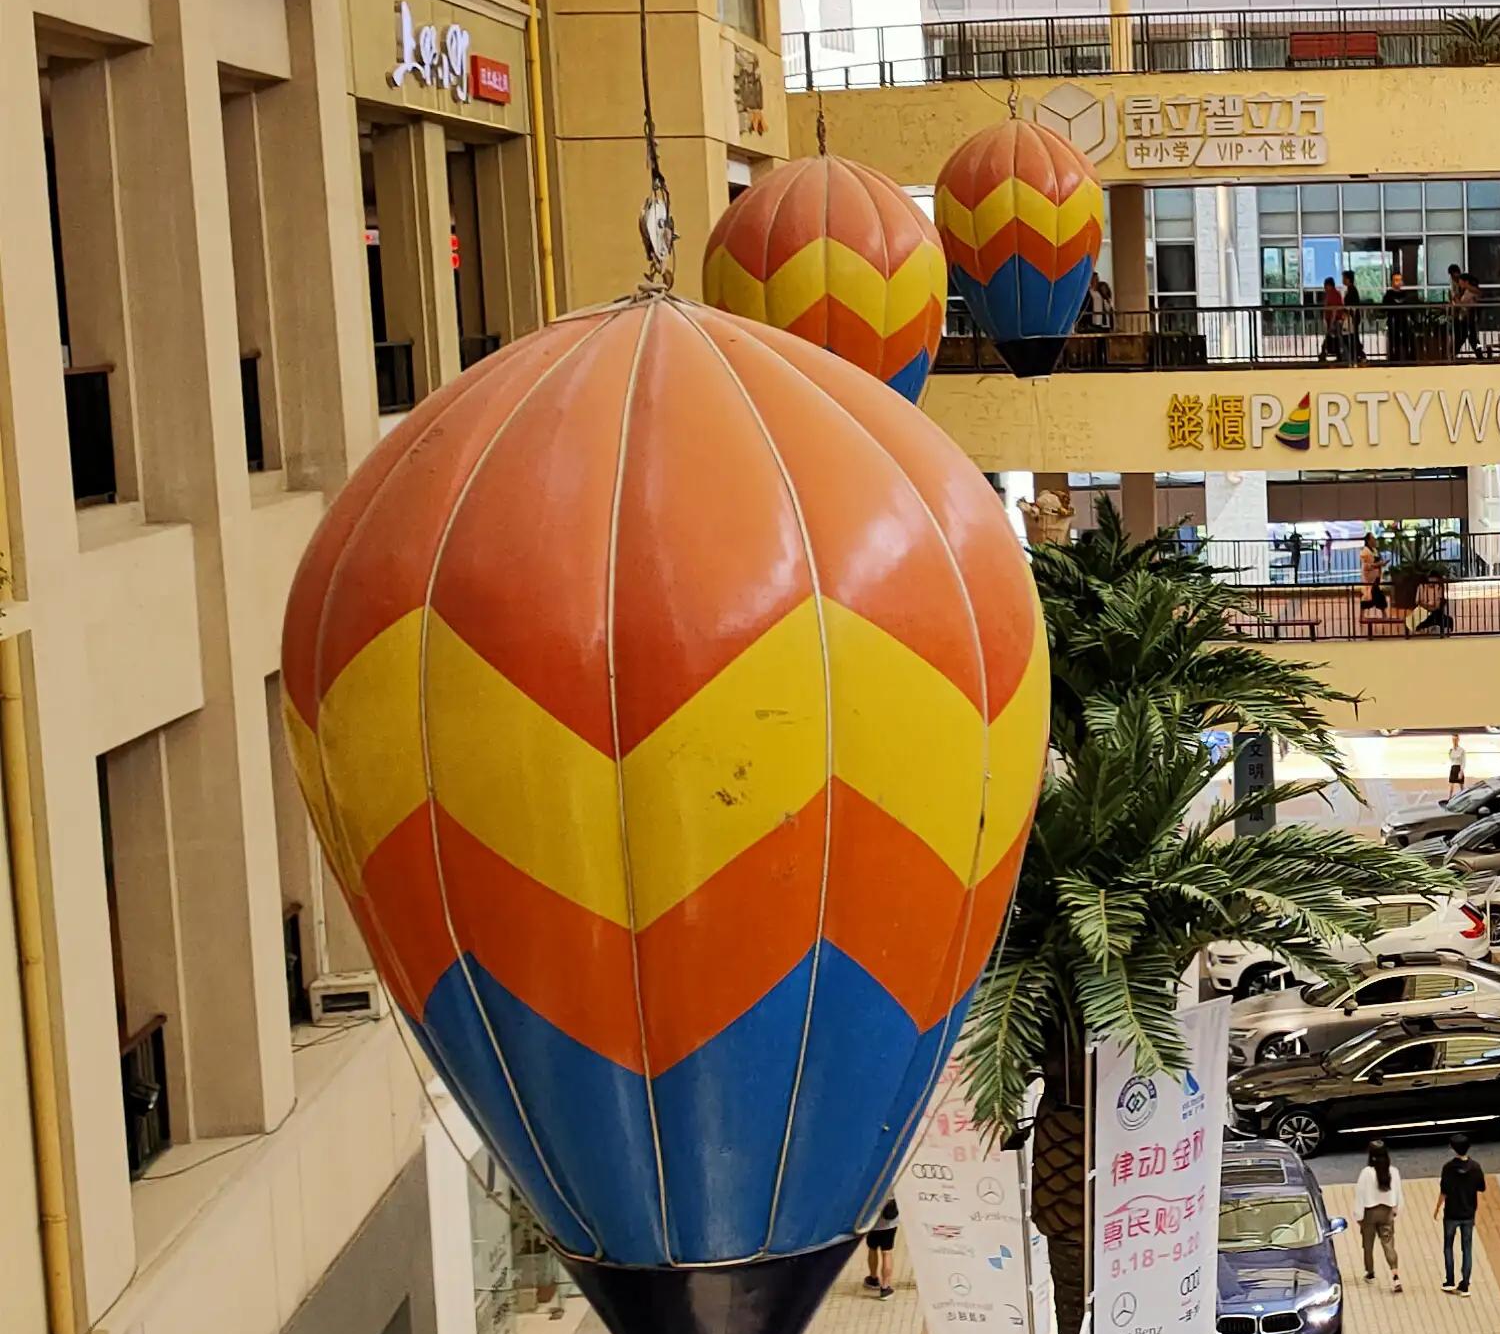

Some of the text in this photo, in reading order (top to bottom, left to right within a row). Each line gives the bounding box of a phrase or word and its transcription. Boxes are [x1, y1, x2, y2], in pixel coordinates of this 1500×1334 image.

[1124, 92, 1327, 137] 昂立智立方
[1133, 141, 1190, 164] 中小学
